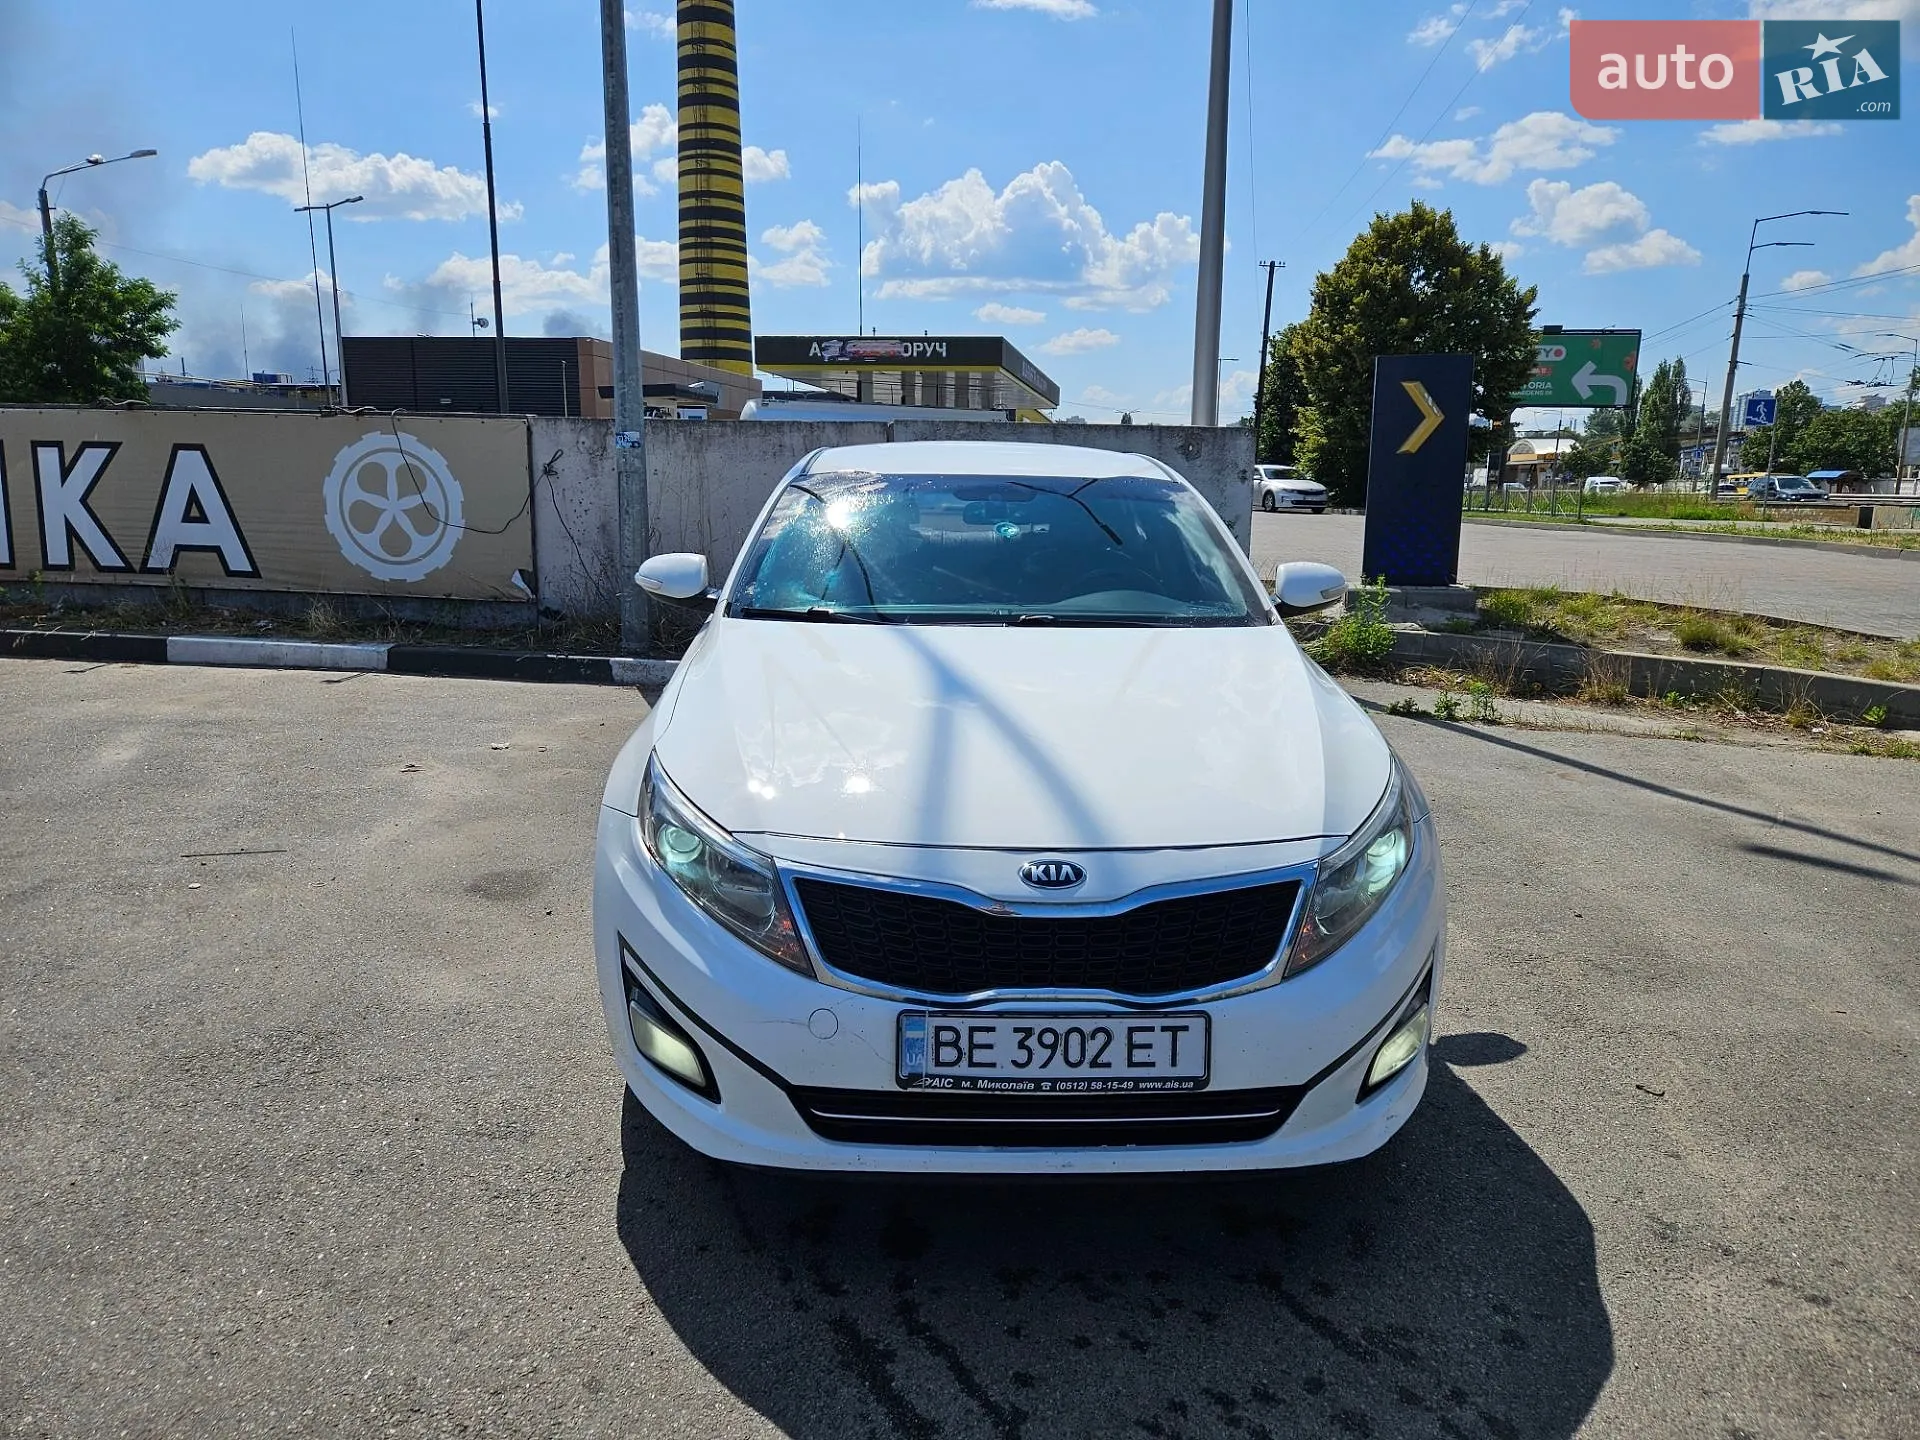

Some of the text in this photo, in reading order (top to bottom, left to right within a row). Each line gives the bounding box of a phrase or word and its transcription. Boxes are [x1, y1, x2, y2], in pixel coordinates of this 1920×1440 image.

[1029, 864, 1077, 882] KIA
[934, 1025, 1190, 1069] BE 3902 ET
[977, 1079, 1035, 1090] Миколаїв
[1056, 1080, 1088, 1091] (0512)
[1090, 1081, 1134, 1090] 58-15-49
[1138, 1080, 1194, 1089] www.ais.ua
